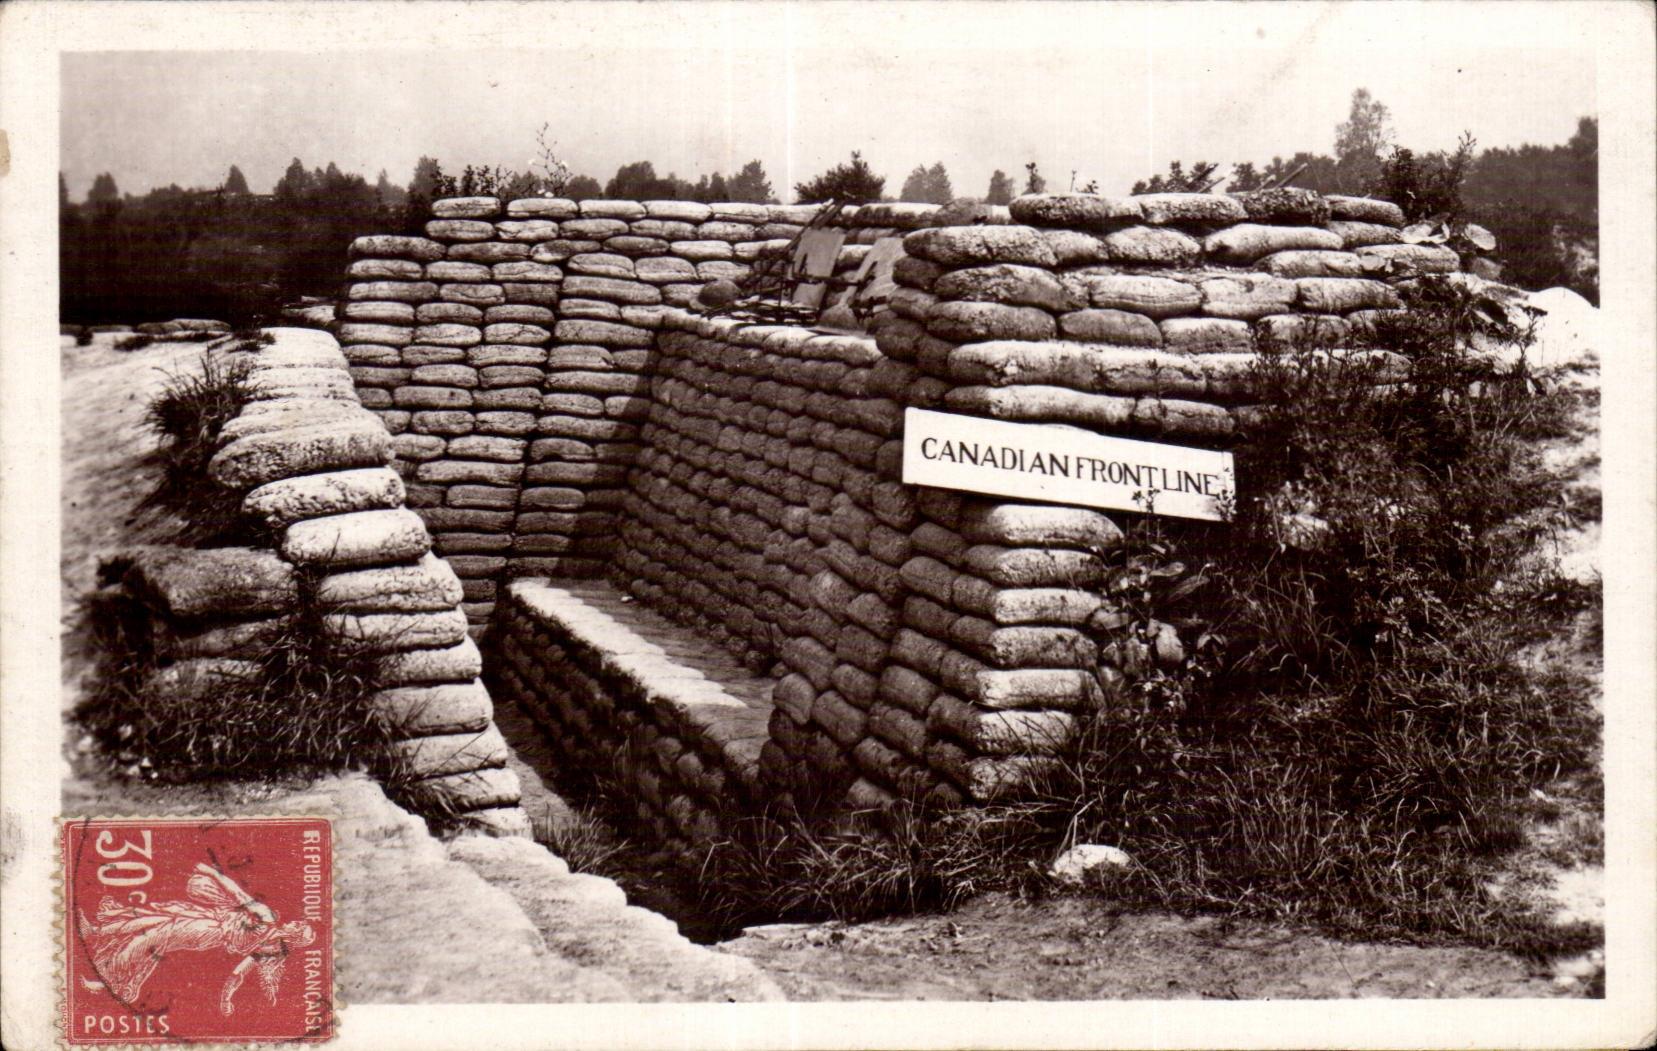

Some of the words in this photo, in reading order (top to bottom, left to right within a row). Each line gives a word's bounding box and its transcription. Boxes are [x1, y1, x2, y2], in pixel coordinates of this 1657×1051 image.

[921, 437, 1069, 477] CANADIAN
[1076, 456, 1159, 489] FRONT
[1162, 468, 1220, 499] LINE
[84, 1015, 170, 1034] POSTES
